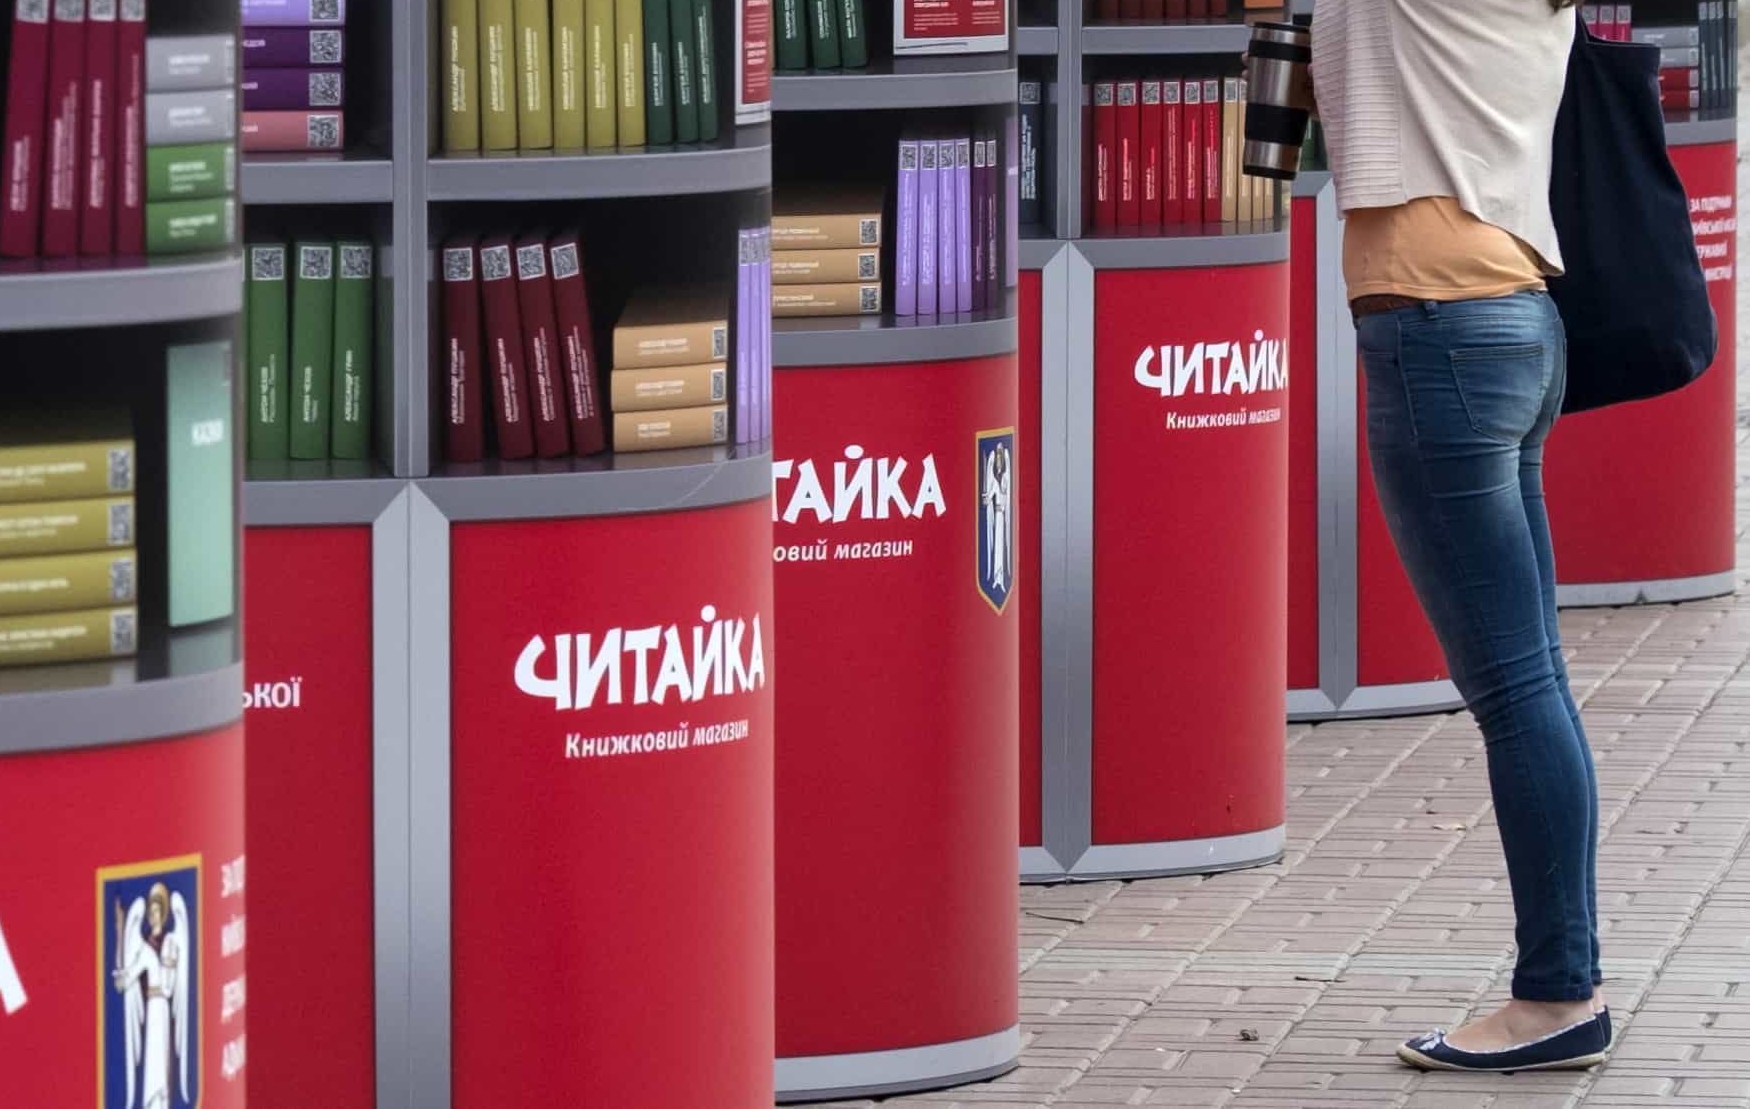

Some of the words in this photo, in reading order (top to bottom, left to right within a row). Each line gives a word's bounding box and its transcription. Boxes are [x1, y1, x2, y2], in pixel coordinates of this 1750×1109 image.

[1134, 329, 1289, 397] ЧИТАЙКА
[1166, 407, 1246, 429] Книжковий
[834, 540, 913, 560] магазин
[513, 604, 765, 710] ЧИТАЙКА
[565, 719, 689, 759] Книжковий
[692, 717, 749, 747] магазин
